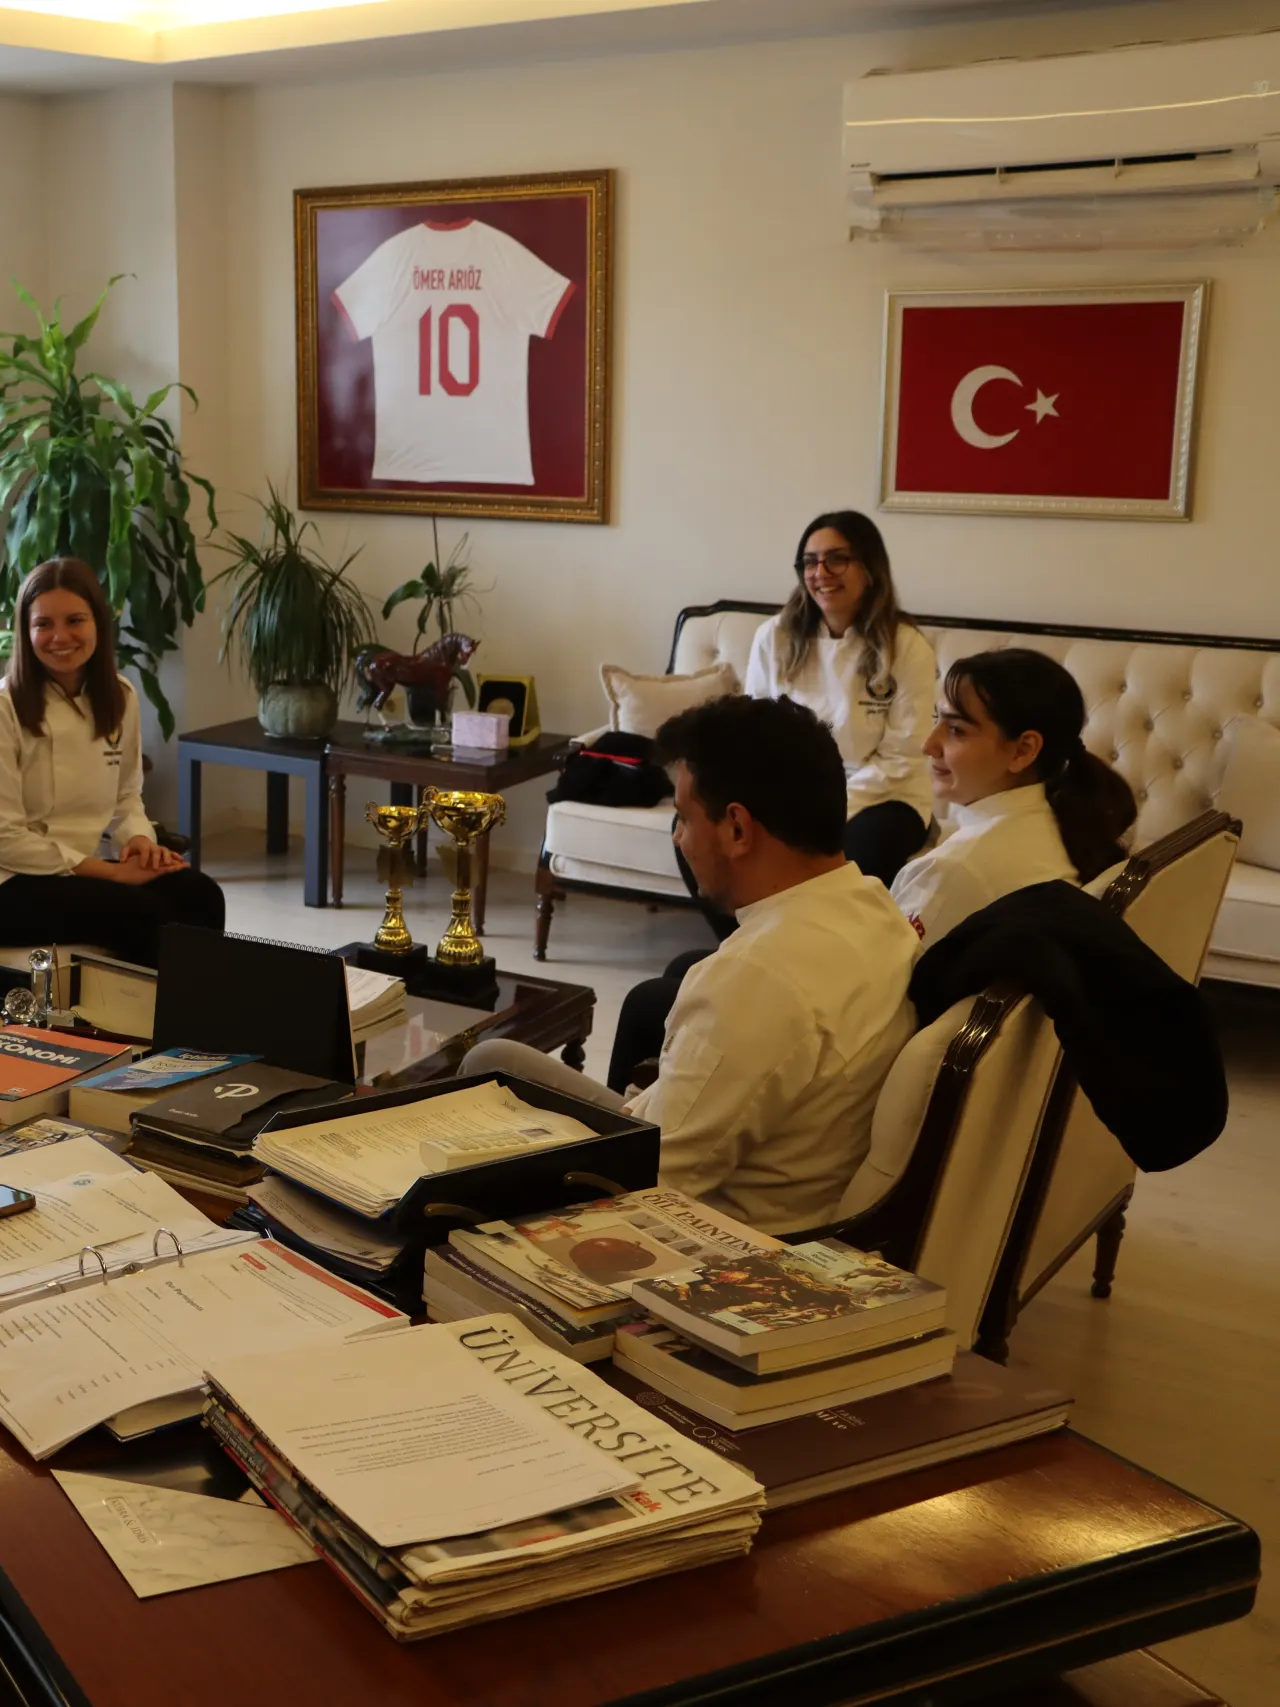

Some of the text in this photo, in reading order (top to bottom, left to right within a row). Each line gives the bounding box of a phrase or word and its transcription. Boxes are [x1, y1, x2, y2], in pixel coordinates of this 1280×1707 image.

[413, 265, 445, 290] ÖMER
[419, 304, 480, 397] 10
[642, 1193, 675, 1211] OIL
[459, 1325, 721, 1505] ÜNİVERSİTE
